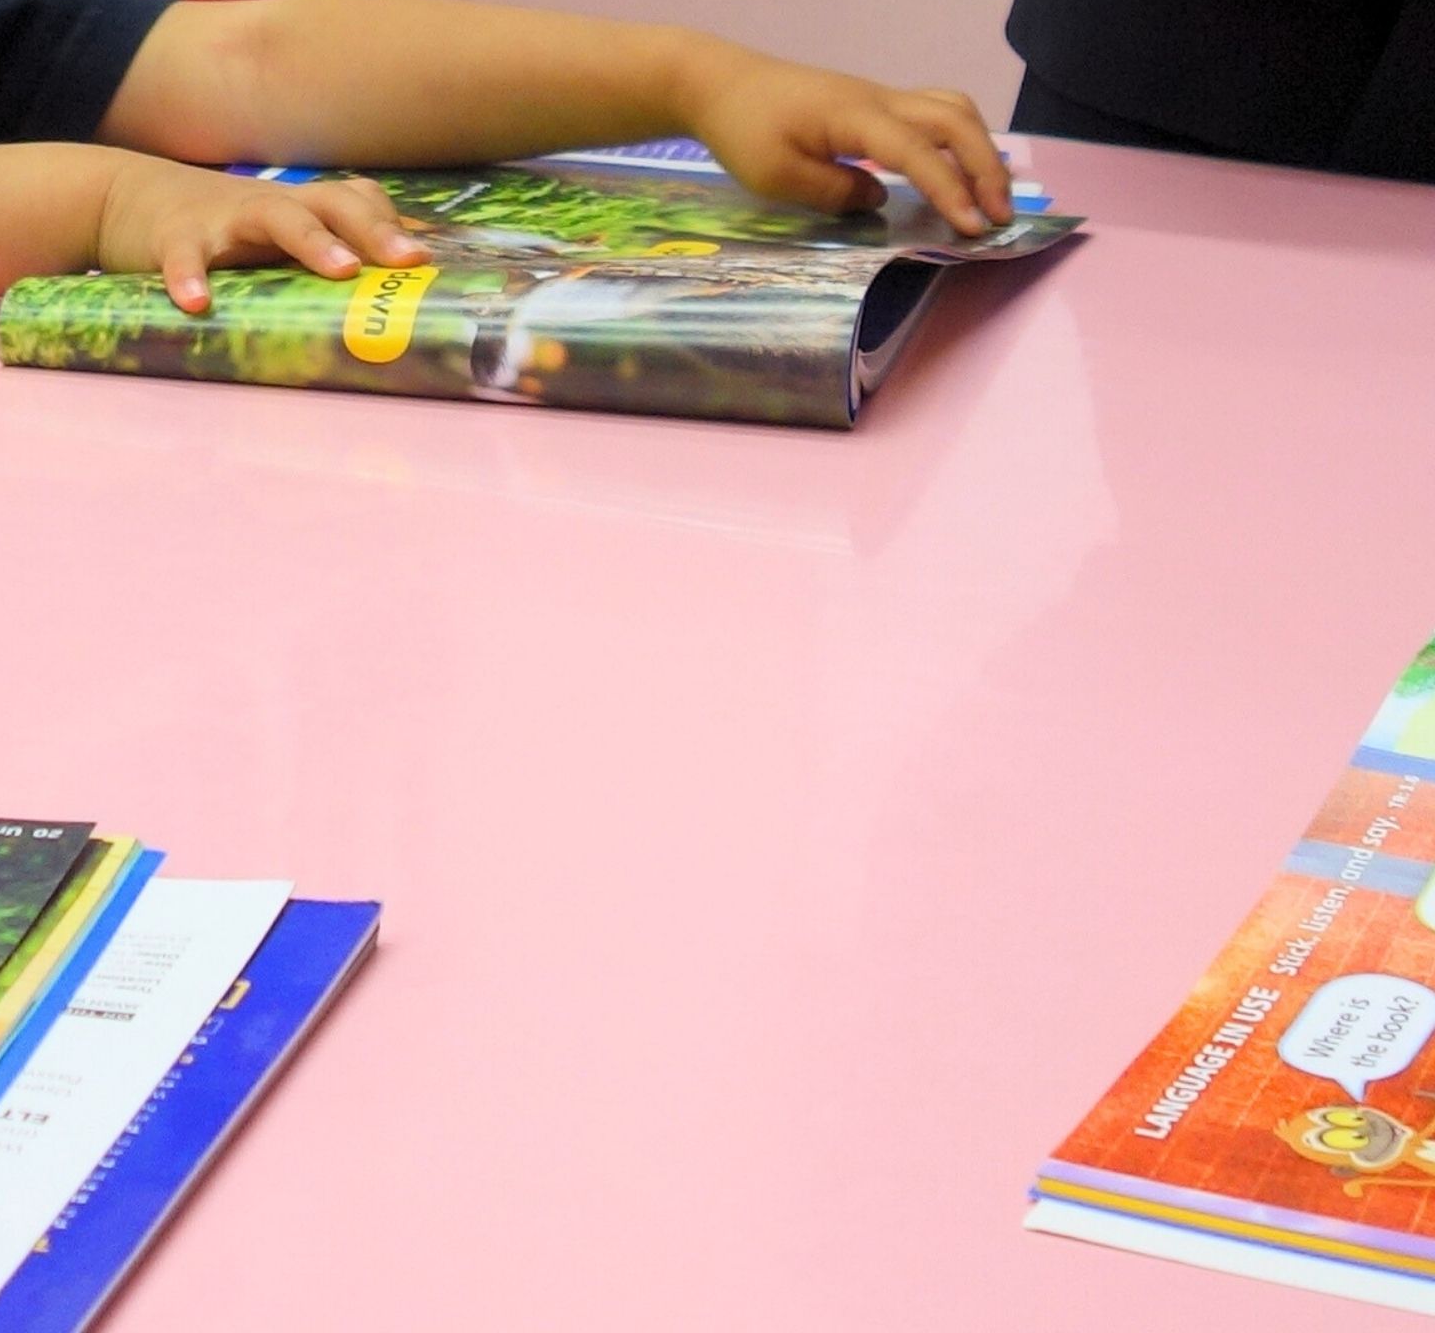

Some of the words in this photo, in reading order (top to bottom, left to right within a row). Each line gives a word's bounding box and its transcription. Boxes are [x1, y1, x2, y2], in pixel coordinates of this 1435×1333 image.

[363, 271, 423, 336] down
[32, 827, 63, 840] 20
[1134, 1042, 1233, 1140] LANGUAGE
[1215, 1012, 1255, 1055] IN
[1240, 985, 1281, 1027] USE
[1269, 935, 1321, 977] Stick,
[1298, 882, 1356, 934] listen,
[1340, 845, 1374, 882] and
[1361, 815, 1402, 847] say.
[1304, 1011, 1361, 1060] Where
[1341, 996, 1371, 1013] is
[1353, 1039, 1388, 1070] the
[1380, 994, 1421, 1042] book?
[0, 1108, 50, 1125] ELT
